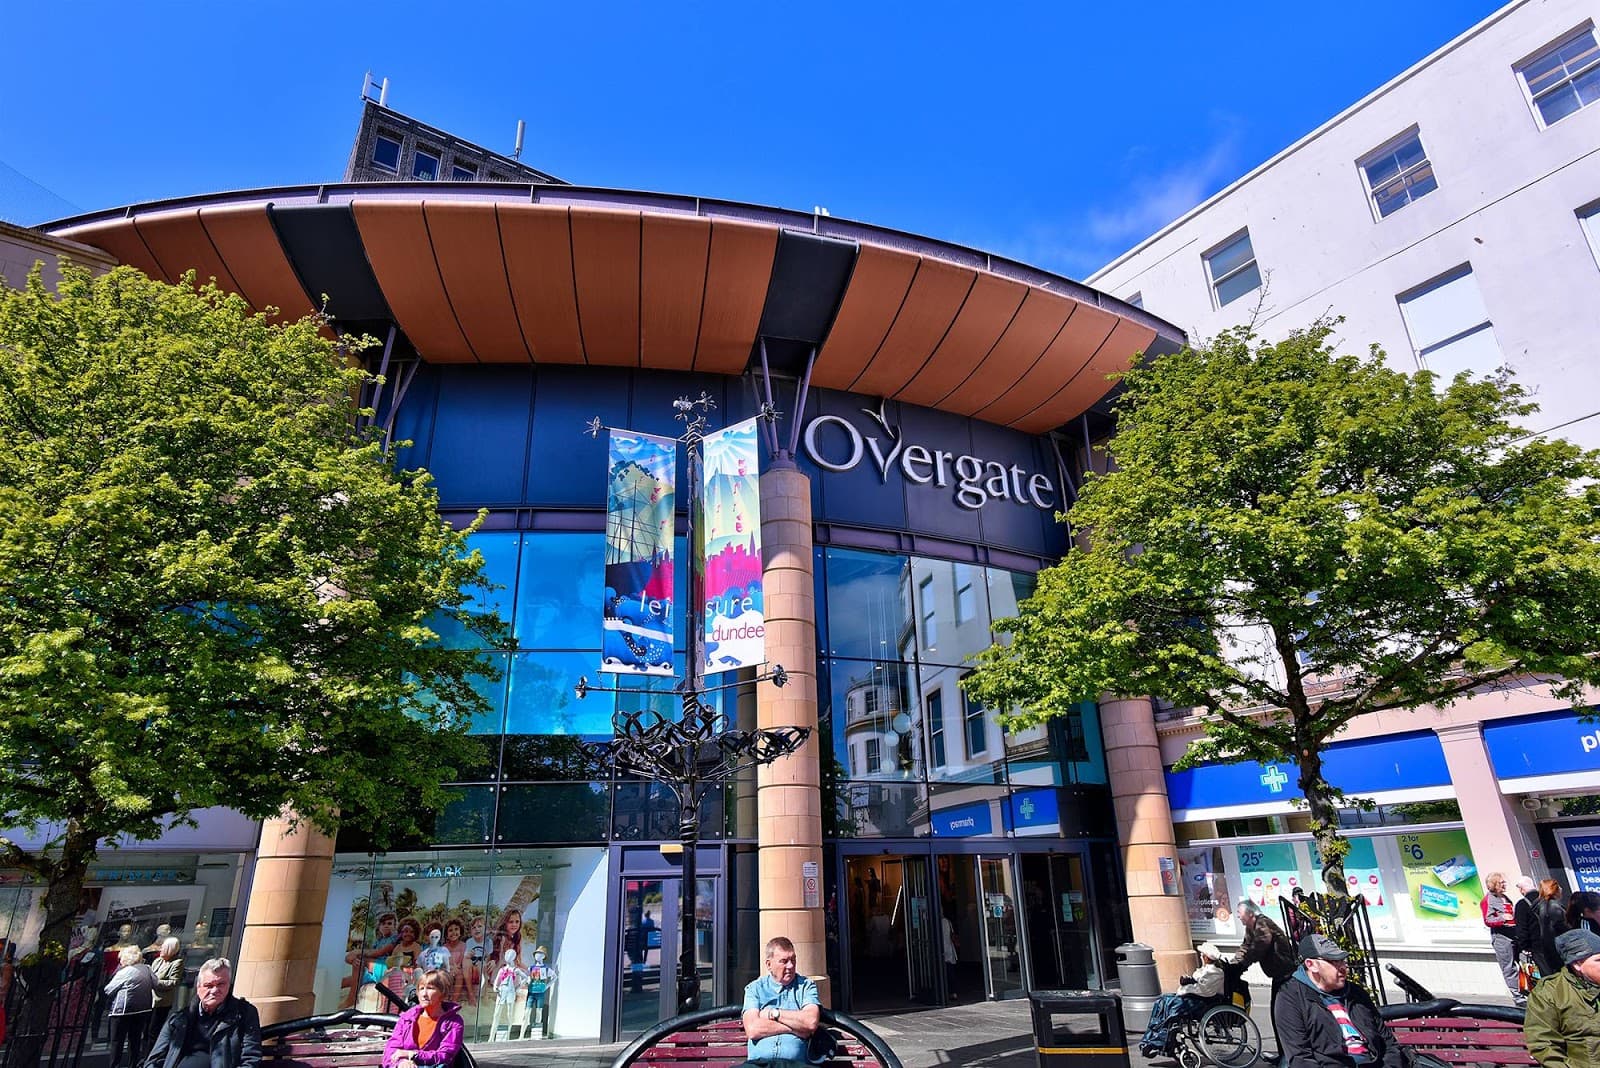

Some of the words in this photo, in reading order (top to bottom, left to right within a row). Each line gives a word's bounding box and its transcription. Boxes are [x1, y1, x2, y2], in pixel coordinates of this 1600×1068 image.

[804, 400, 1054, 510] Overgate
[640, 589, 672, 618] lei
[705, 596, 753, 617] sure
[711, 622, 765, 642] dundee
[1241, 851, 1264, 867] 25p
[1404, 843, 1424, 860] £6
